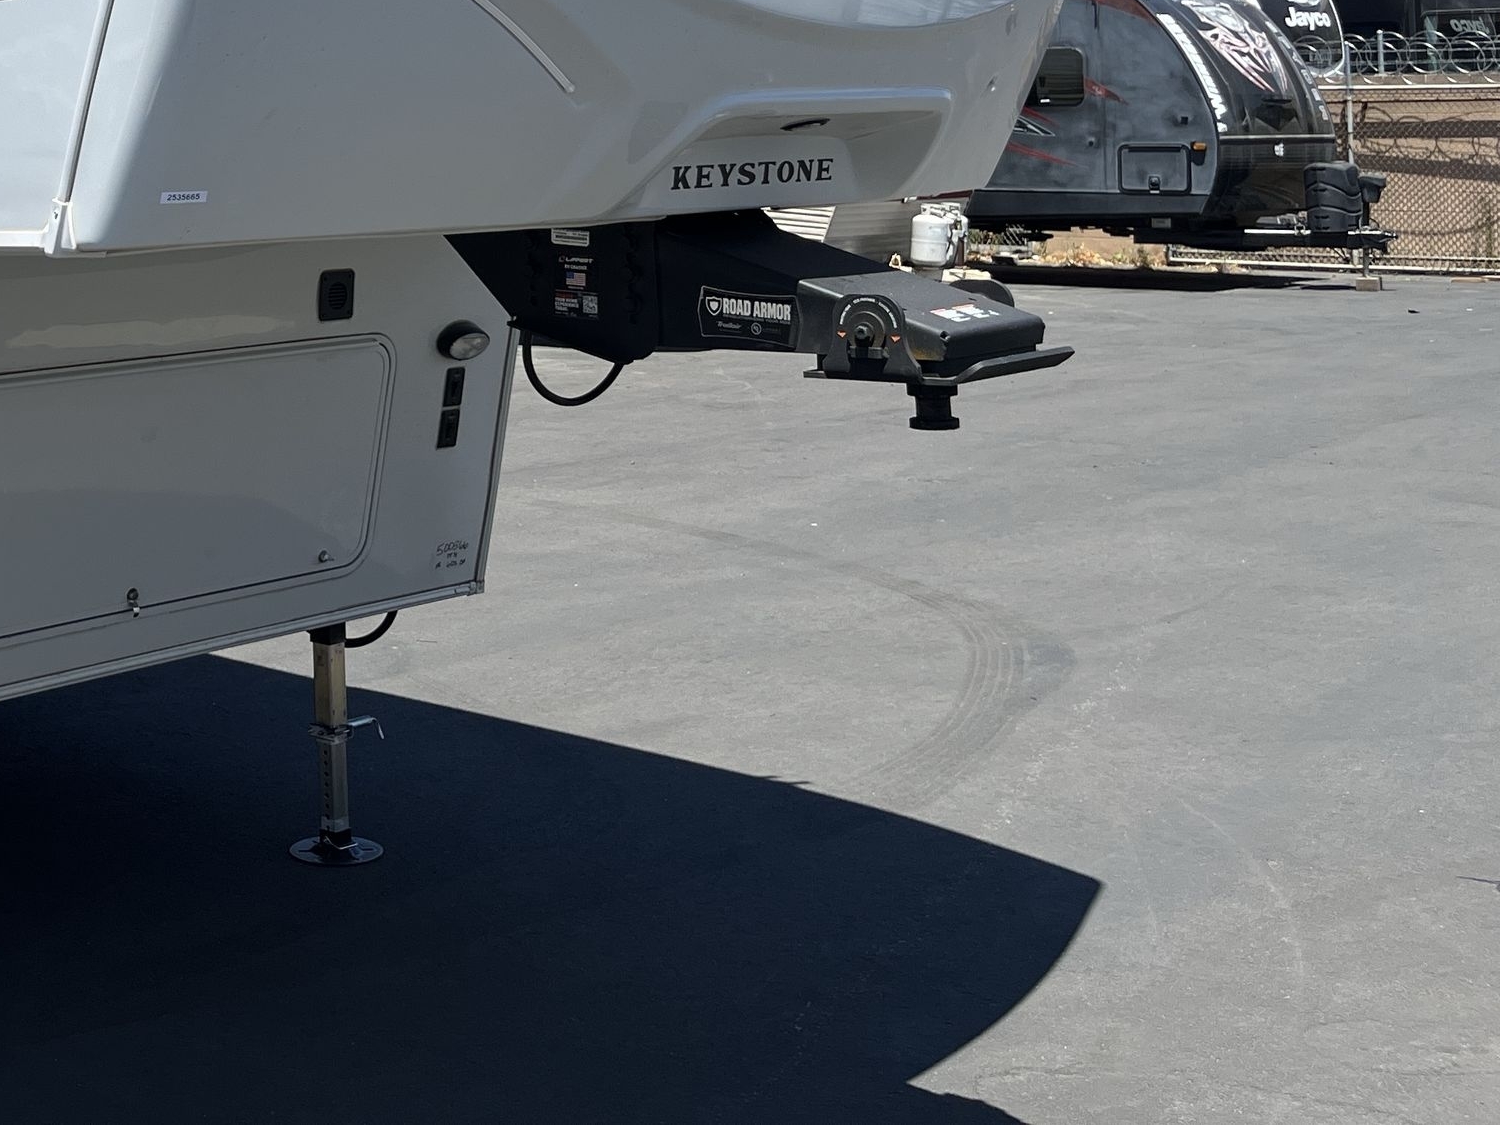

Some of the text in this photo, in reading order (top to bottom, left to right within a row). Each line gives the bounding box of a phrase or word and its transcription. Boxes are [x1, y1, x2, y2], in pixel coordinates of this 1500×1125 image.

[1284, 6, 1332, 31] Jayco
[670, 158, 834, 191] KEYSTONE
[722, 297, 752, 317] ROAD
[753, 301, 791, 321] ARMOR
